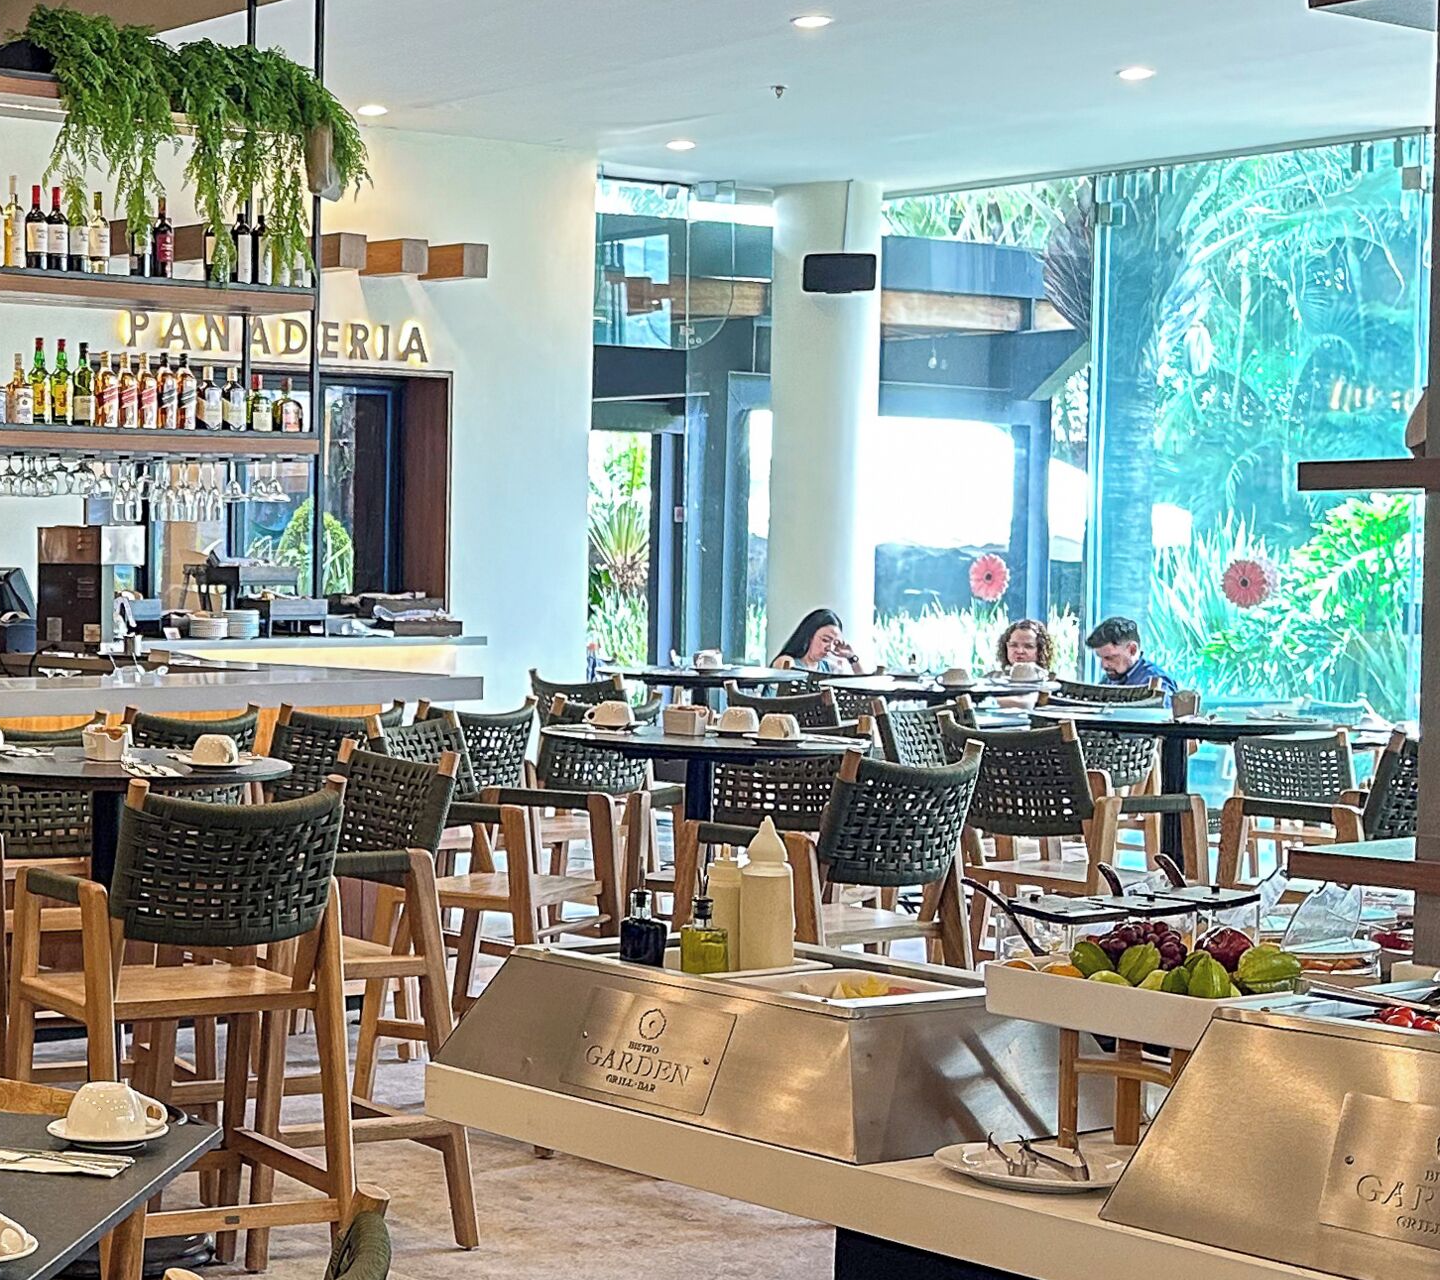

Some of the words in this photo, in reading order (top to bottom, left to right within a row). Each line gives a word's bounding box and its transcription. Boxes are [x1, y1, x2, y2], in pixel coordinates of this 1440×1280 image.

[125, 310, 429, 363] PANADERIA
[584, 1044, 693, 1087] GARDEN
[627, 1040, 660, 1055] BISTRO
